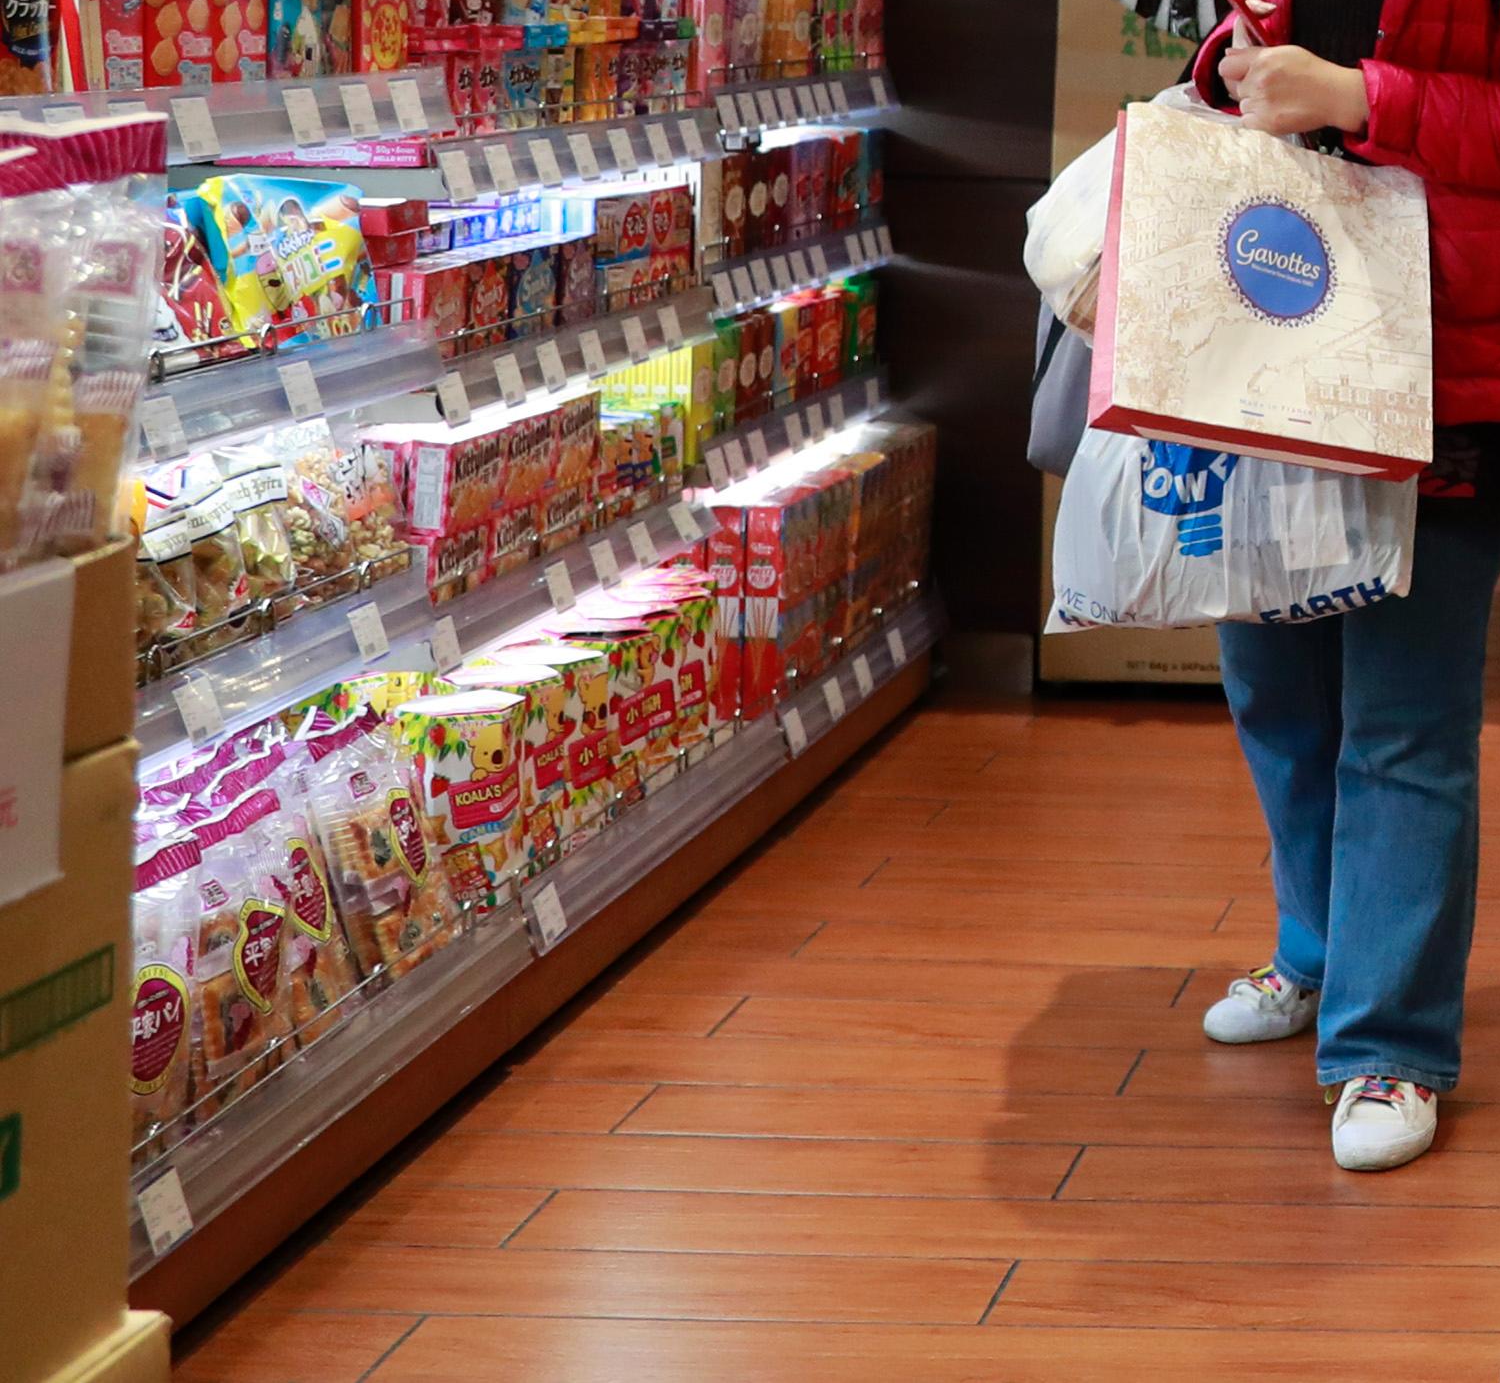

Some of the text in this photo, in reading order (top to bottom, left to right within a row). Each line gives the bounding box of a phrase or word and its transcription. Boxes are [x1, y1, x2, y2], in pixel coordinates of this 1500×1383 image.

[1235, 228, 1321, 282] Gavottes
[1259, 576, 1387, 625] EARTH
[455, 783, 501, 808] KOALA'S
